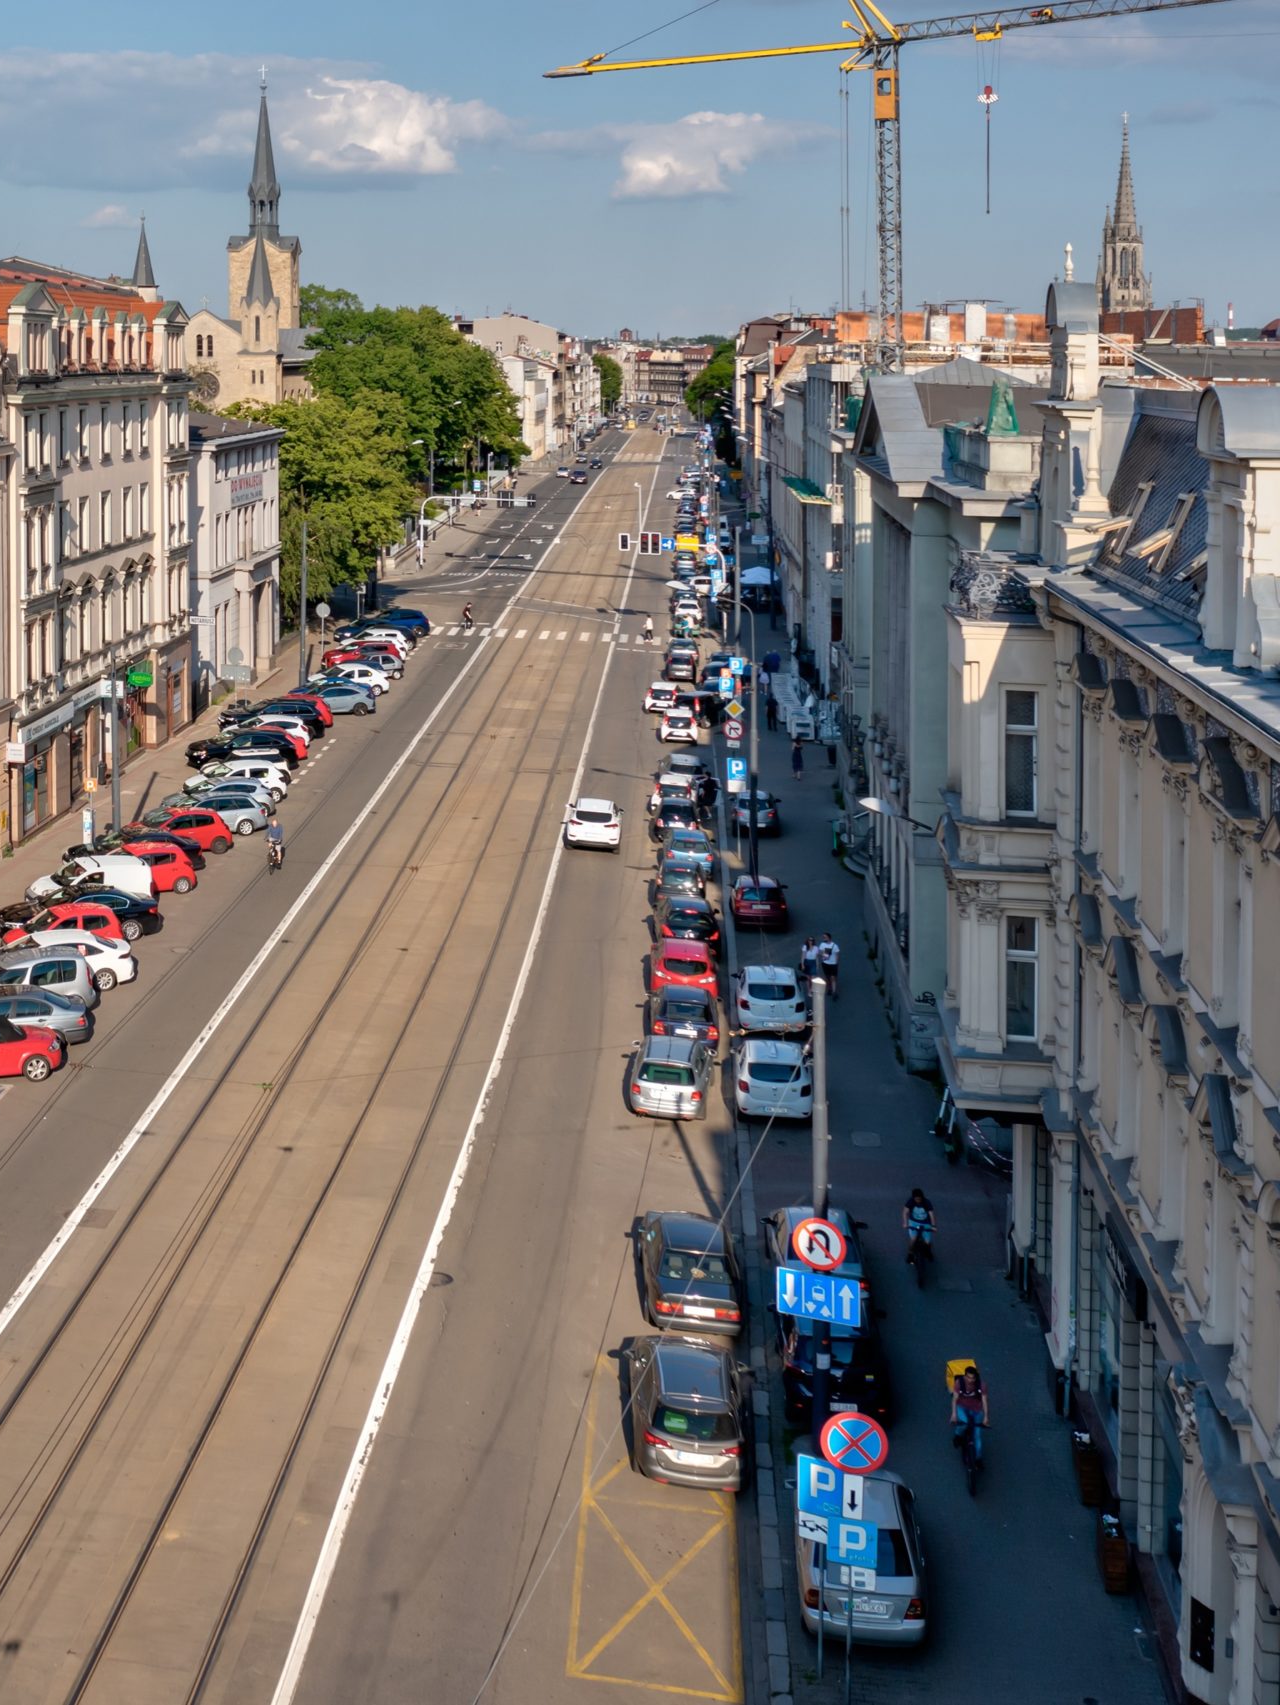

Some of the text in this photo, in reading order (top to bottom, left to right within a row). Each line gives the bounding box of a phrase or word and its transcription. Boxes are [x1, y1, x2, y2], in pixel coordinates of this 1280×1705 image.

[732, 760, 743, 774] P
[810, 1463, 835, 1497] P
[839, 1523, 866, 1558] P
